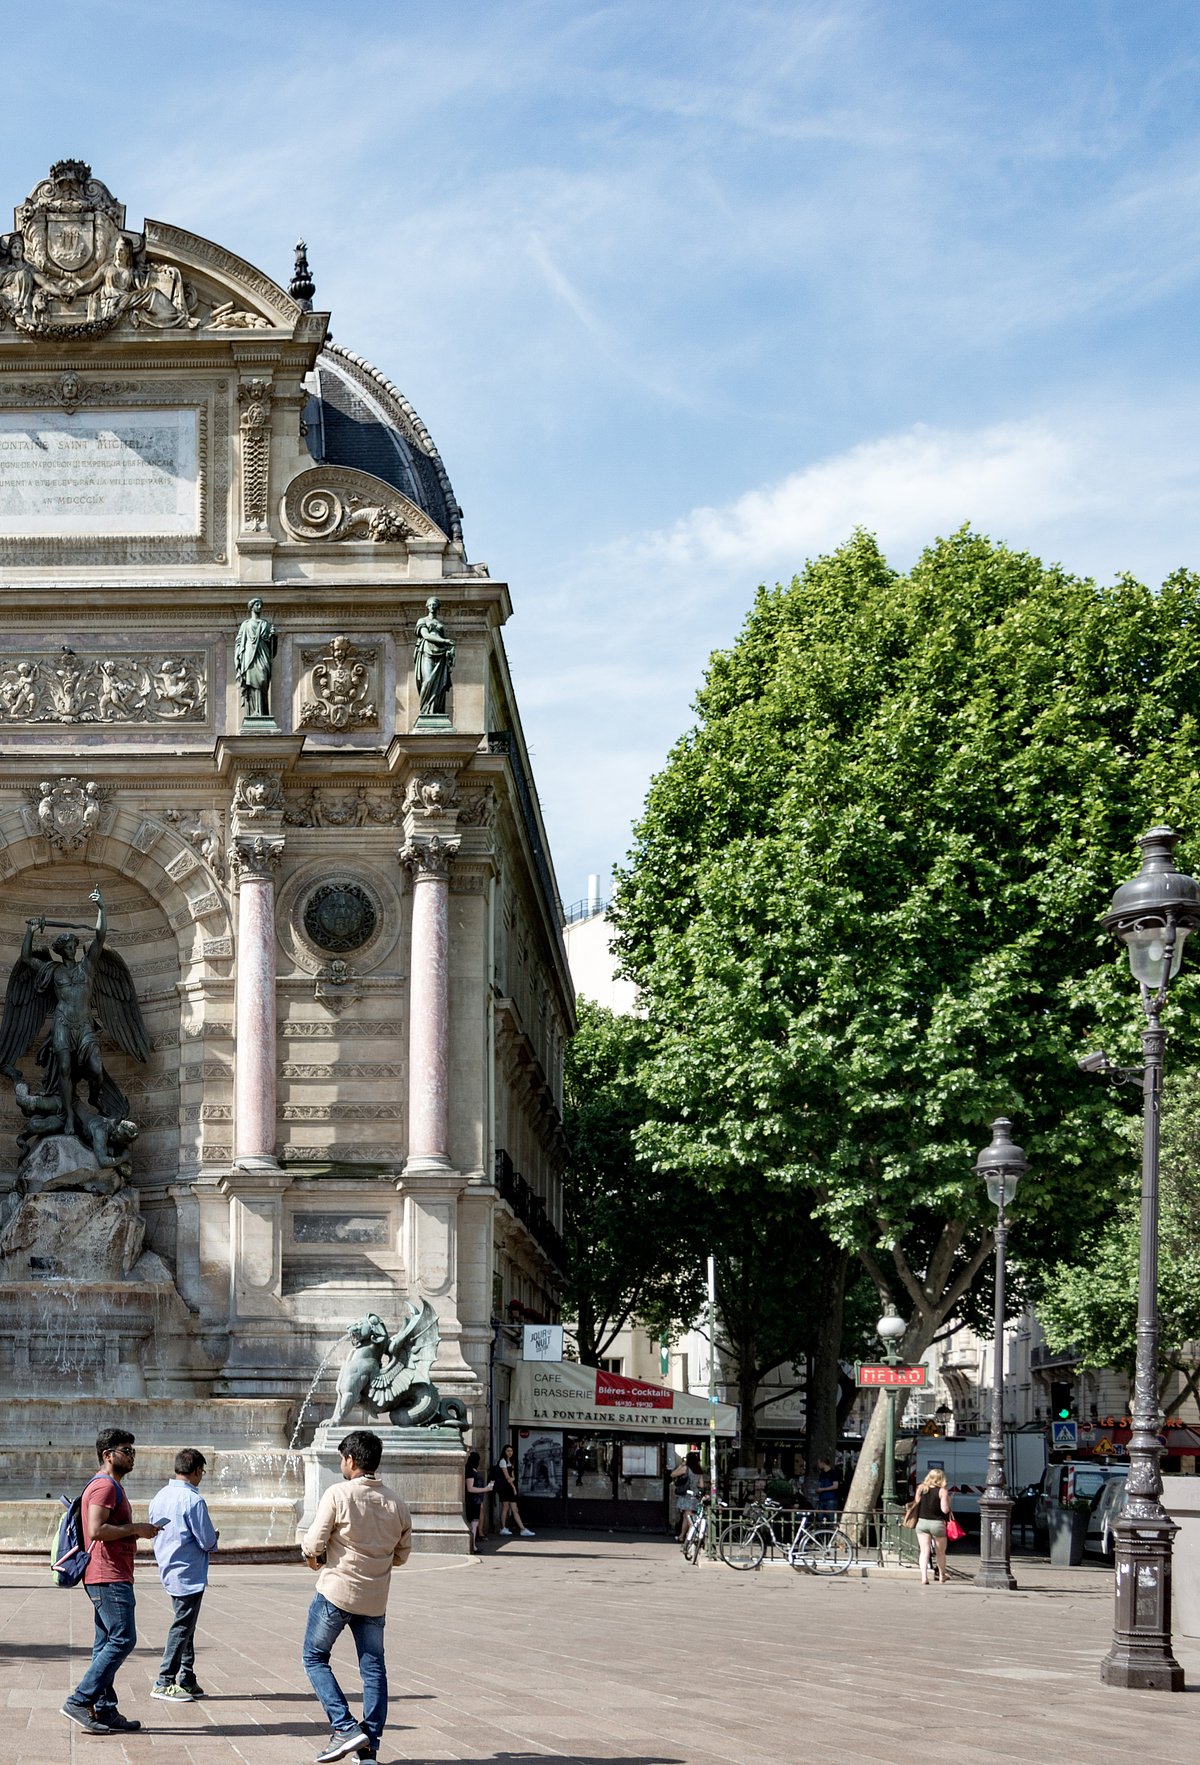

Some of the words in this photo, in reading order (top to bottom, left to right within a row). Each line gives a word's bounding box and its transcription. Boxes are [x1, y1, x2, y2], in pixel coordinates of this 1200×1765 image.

[58, 440, 88, 450] SAINT
[97, 439, 143, 449] MICHEL
[530, 1329, 547, 1342] JOUR
[535, 1335, 551, 1349] NUIT
[534, 1373, 562, 1383] CAFE
[863, 1369, 921, 1382] METRO
[533, 1388, 593, 1399] BRASSERIE
[631, 1387, 671, 1397] Cocktails
[533, 1409, 548, 1419] LA
[553, 1410, 615, 1421] FONTAINE
[619, 1413, 658, 1423] SAINT
[662, 1416, 710, 1426] MICHEL
[1100, 1415, 1115, 1427] LE
